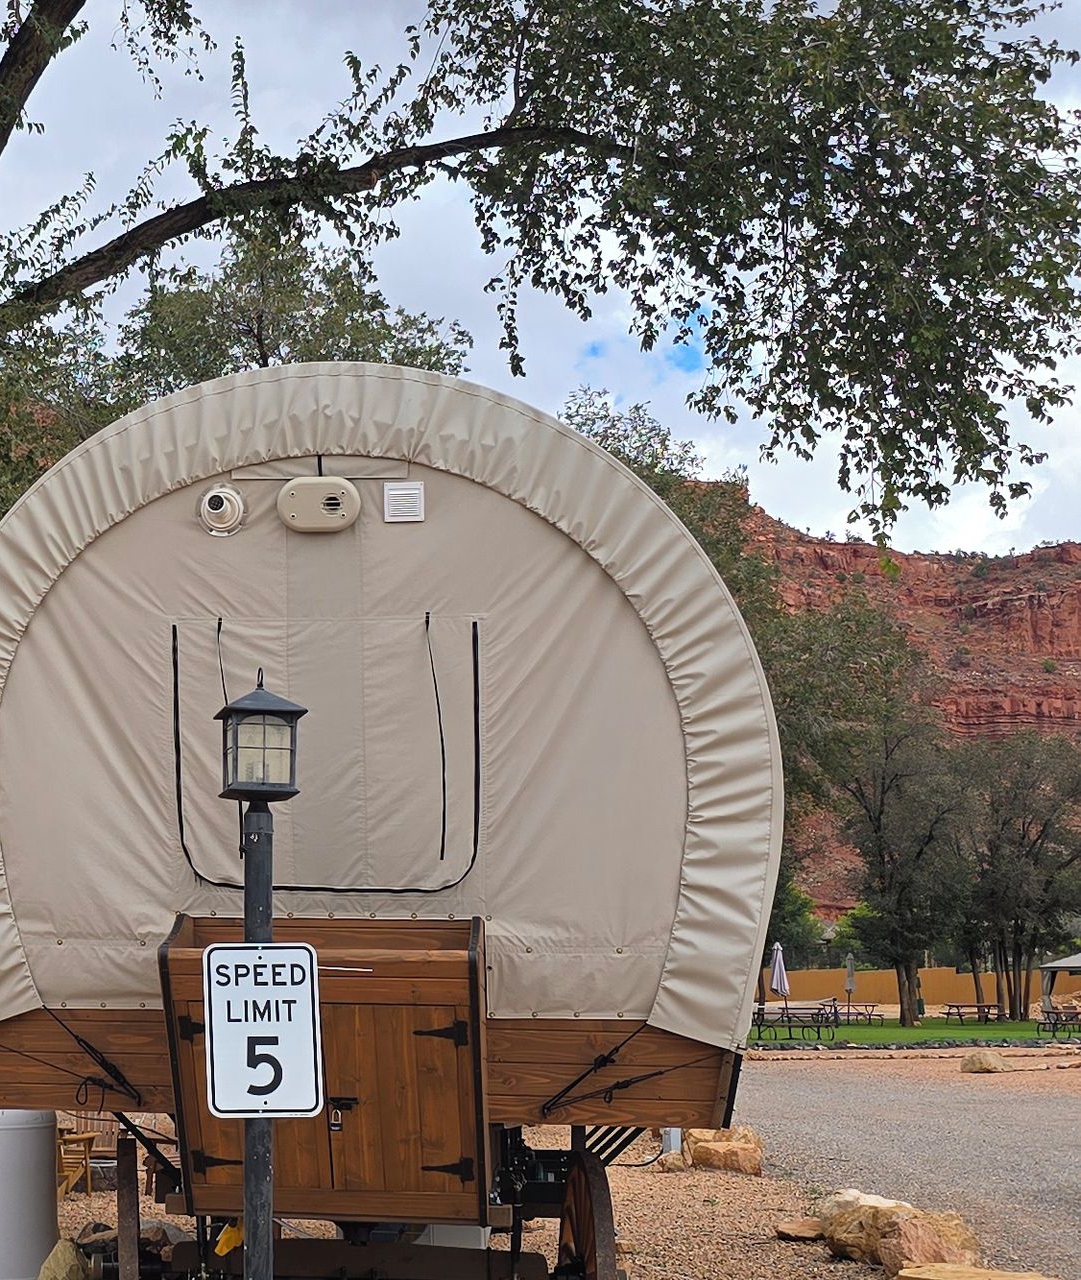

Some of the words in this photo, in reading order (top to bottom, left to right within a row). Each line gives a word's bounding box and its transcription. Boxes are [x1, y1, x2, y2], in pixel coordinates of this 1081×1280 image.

[215, 963, 306, 987] SPEED
[226, 999, 297, 1023] LIMIT
[246, 1036, 283, 1096] 5
